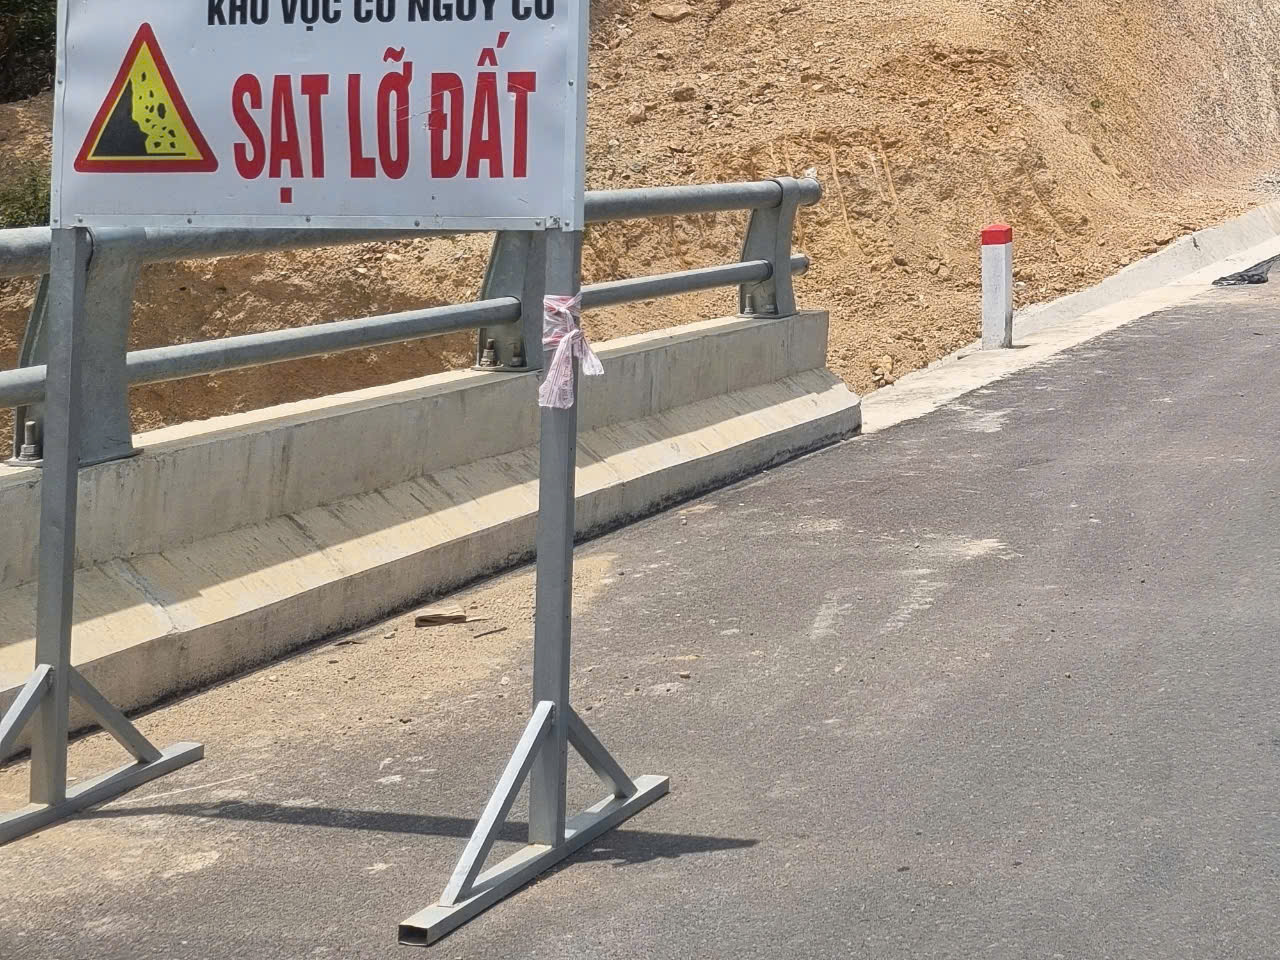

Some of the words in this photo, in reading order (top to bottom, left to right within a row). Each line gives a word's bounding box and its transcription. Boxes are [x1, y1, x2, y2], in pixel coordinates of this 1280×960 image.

[231, 73, 330, 204] SẠT
[347, 46, 413, 180] LỠ
[428, 31, 537, 179] ĐẤT
